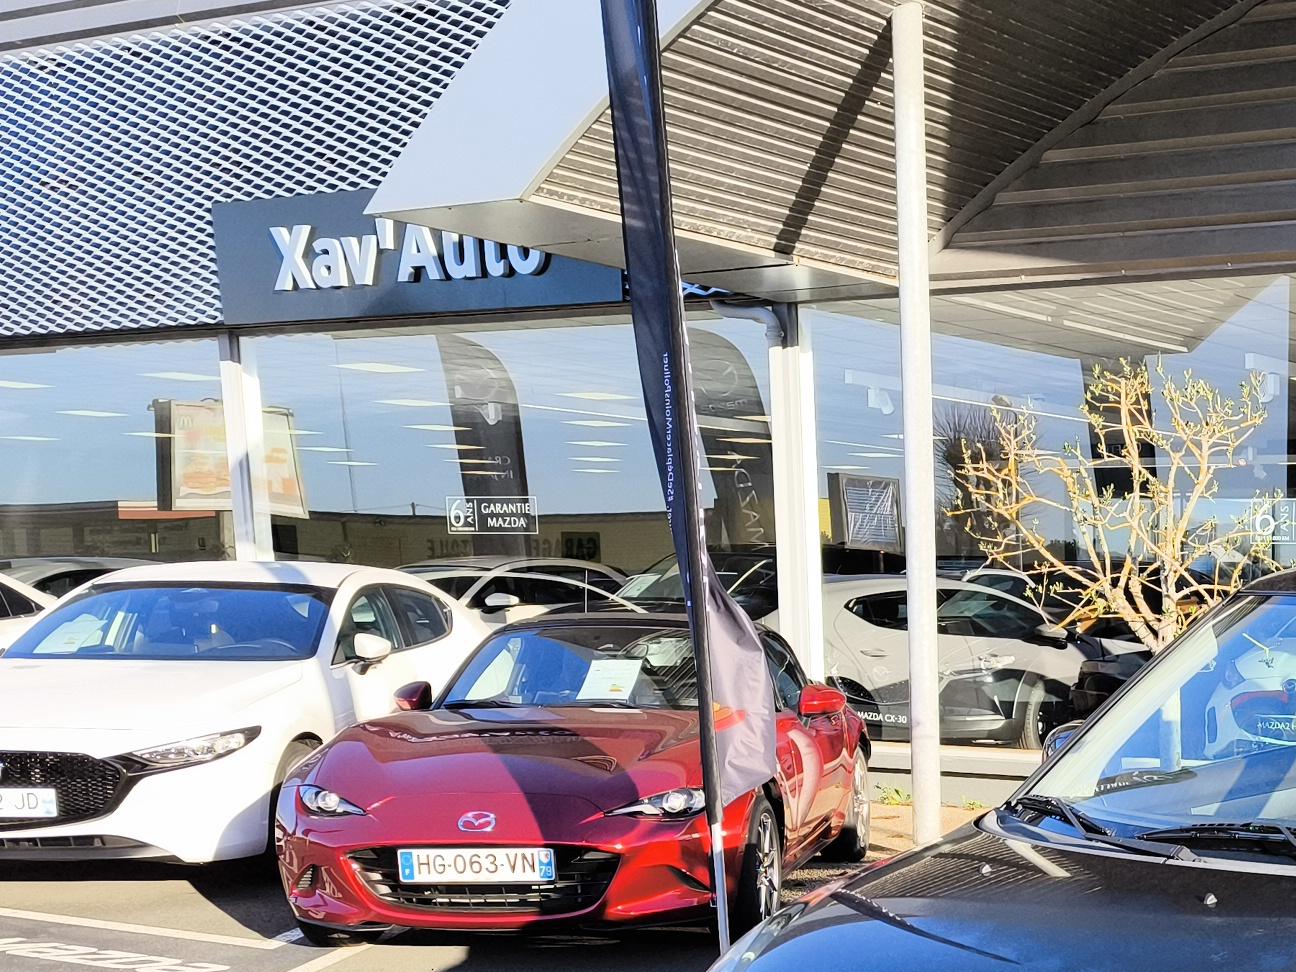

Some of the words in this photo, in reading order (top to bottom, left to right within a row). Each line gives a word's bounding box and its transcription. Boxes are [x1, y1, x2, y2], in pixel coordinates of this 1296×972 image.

[451, 500, 465, 527] 6
[481, 503, 530, 514] GARANTIE
[487, 517, 526, 528] MAZDA
[857, 711, 884, 722] MAZDA
[885, 714, 907, 724] CX-30
[416, 853, 536, 875] HG-063-VN
